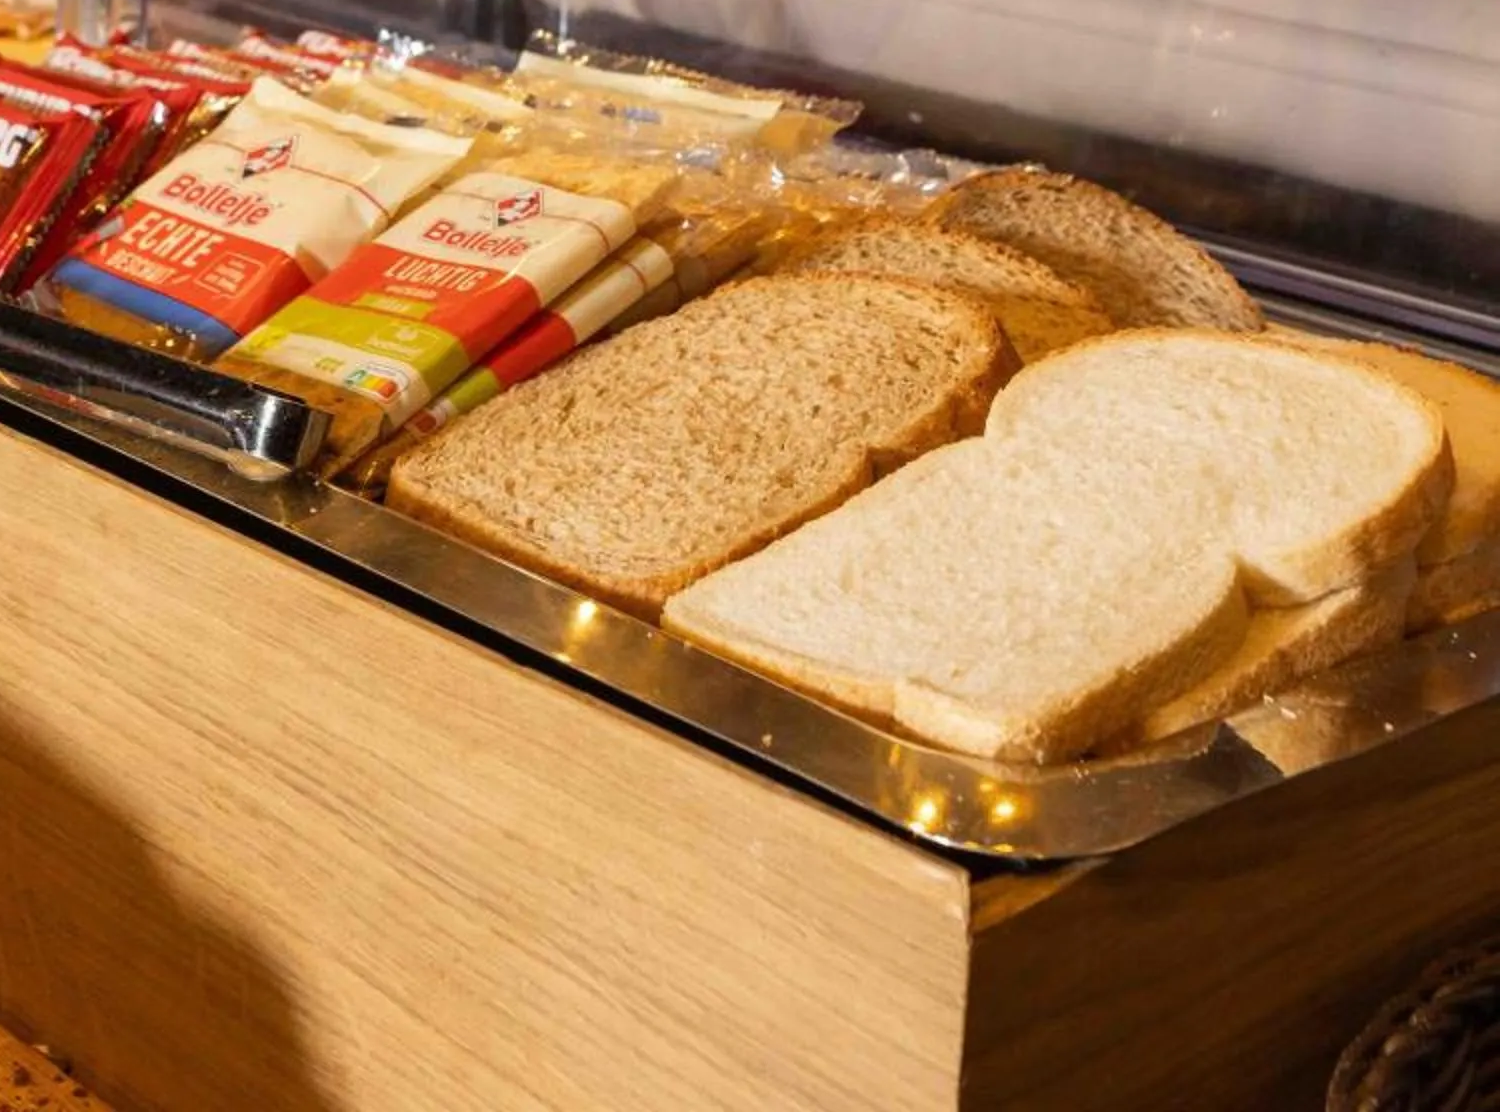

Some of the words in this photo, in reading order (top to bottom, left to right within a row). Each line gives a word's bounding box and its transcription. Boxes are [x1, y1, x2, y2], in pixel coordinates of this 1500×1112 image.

[163, 172, 273, 228] Bolletje
[118, 210, 226, 268] ECHTE
[421, 217, 531, 259] Bolletje
[384, 255, 490, 293] LUCHTIG
